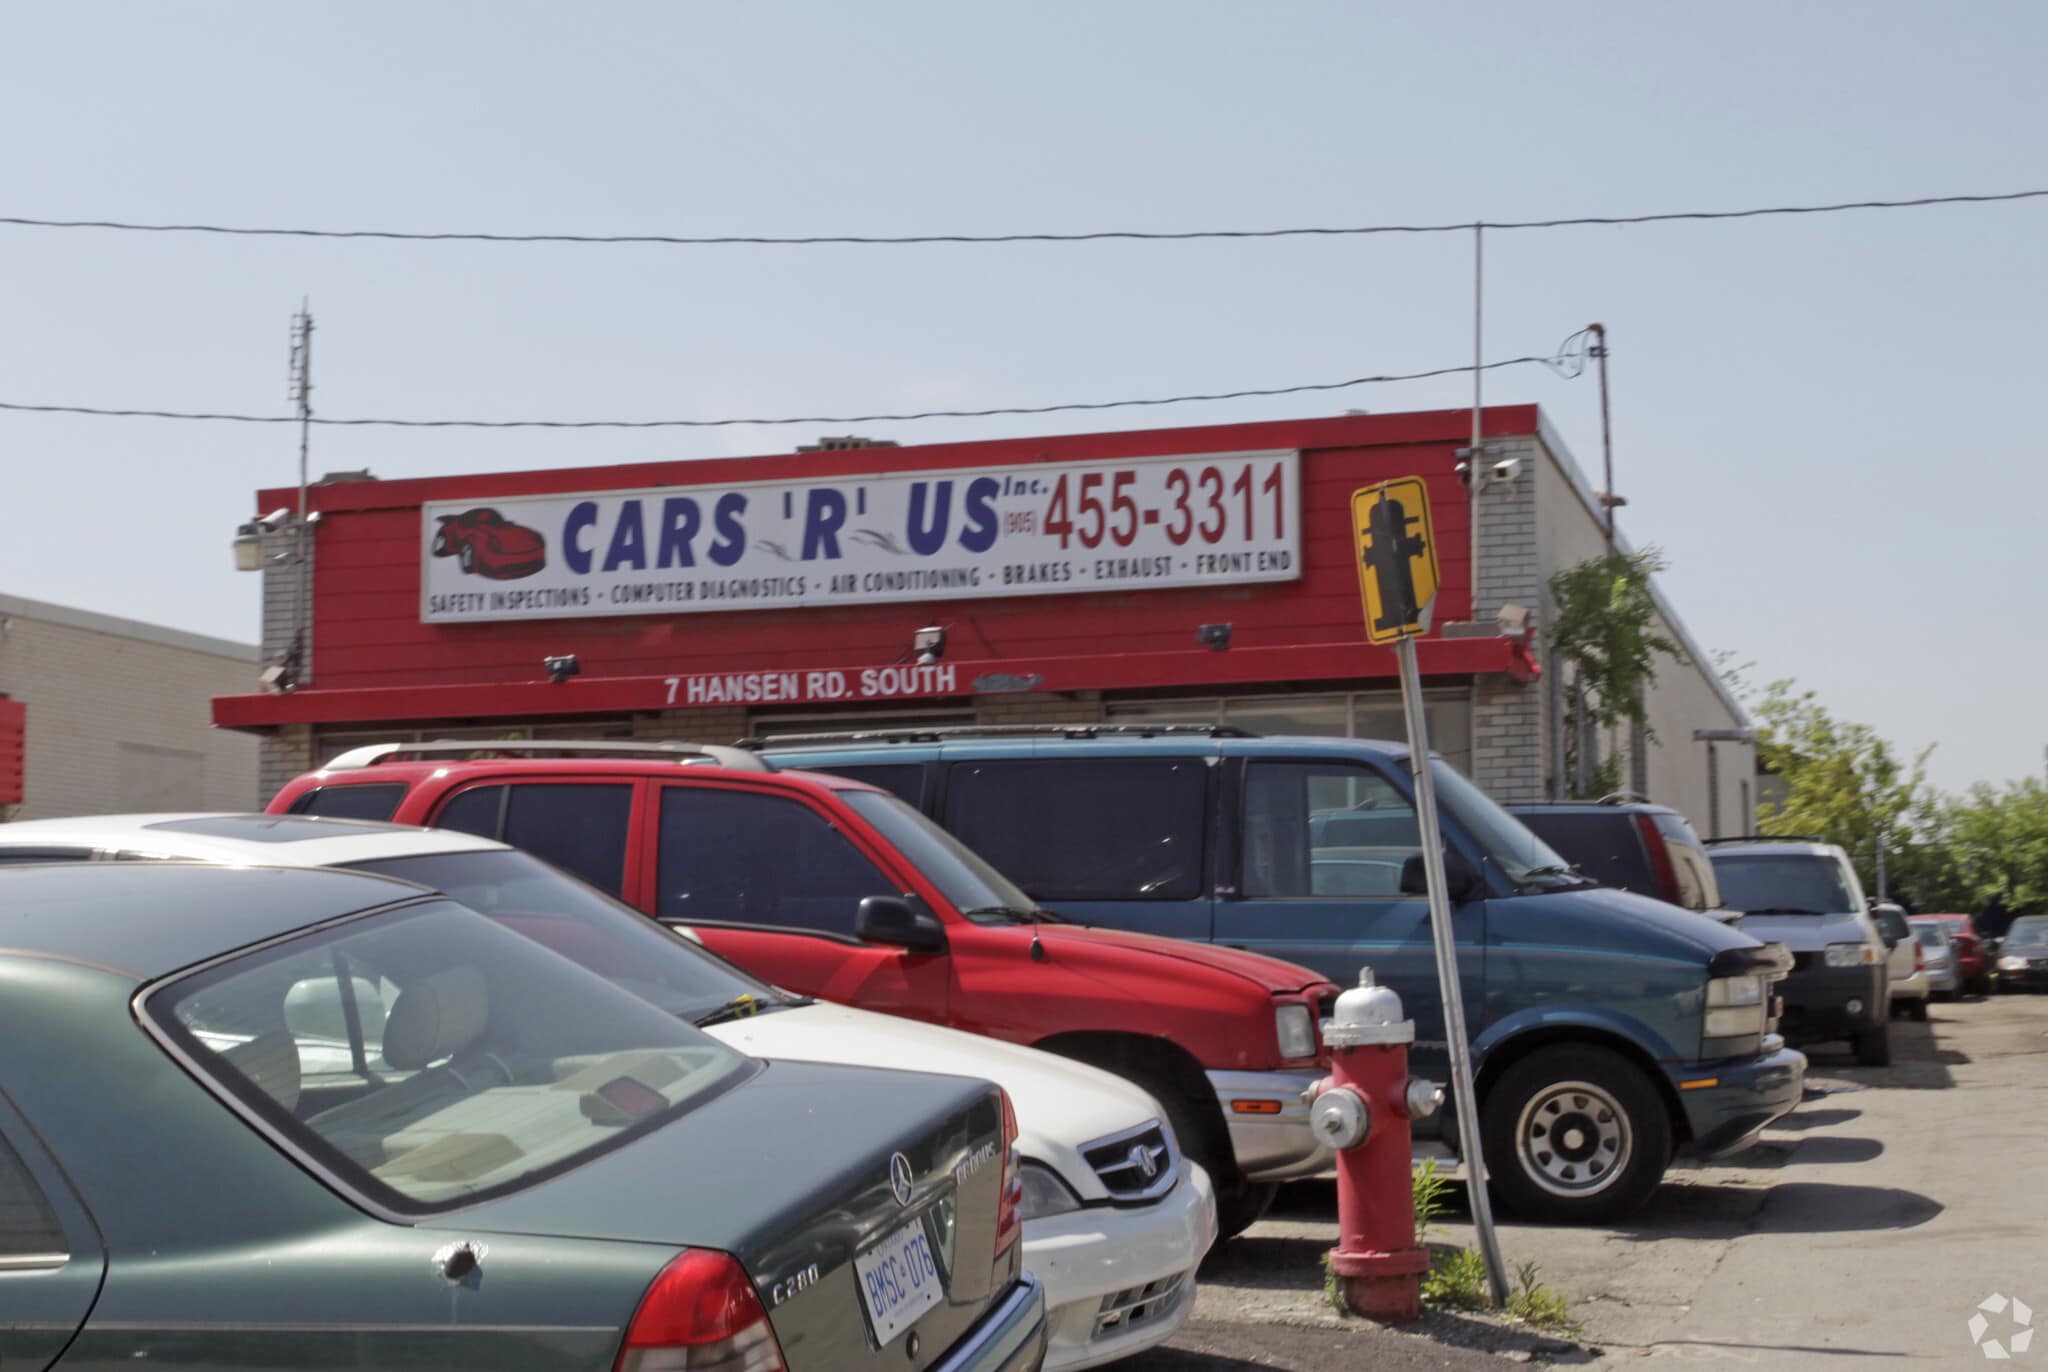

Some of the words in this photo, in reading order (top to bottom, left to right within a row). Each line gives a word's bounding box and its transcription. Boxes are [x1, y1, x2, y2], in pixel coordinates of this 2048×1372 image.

[562, 492, 749, 575] CARS
[783, 486, 868, 561] 'R'
[906, 476, 1001, 556] US
[1003, 475, 1048, 496] Inc.
[1003, 511, 1037, 537] (905)
[1043, 461, 1285, 550] 455-3311
[430, 592, 485, 614] SAFETY
[489, 586, 590, 611] INSPECTIONS
[611, 581, 694, 604] COMPUTER
[700, 576, 806, 600] DIAGNOSTICS
[829, 574, 858, 594] AIR
[863, 567, 980, 592] CONDITIONING
[1003, 561, 1072, 585] BRAKES
[1094, 555, 1172, 580] EXHAUST
[1195, 551, 1252, 574] FRONT
[1257, 550, 1292, 572] END
[664, 678, 680, 704] 7
[687, 673, 798, 704] HANSEN
[806, 671, 853, 699] RD.
[860, 665, 956, 697] SOUTH
